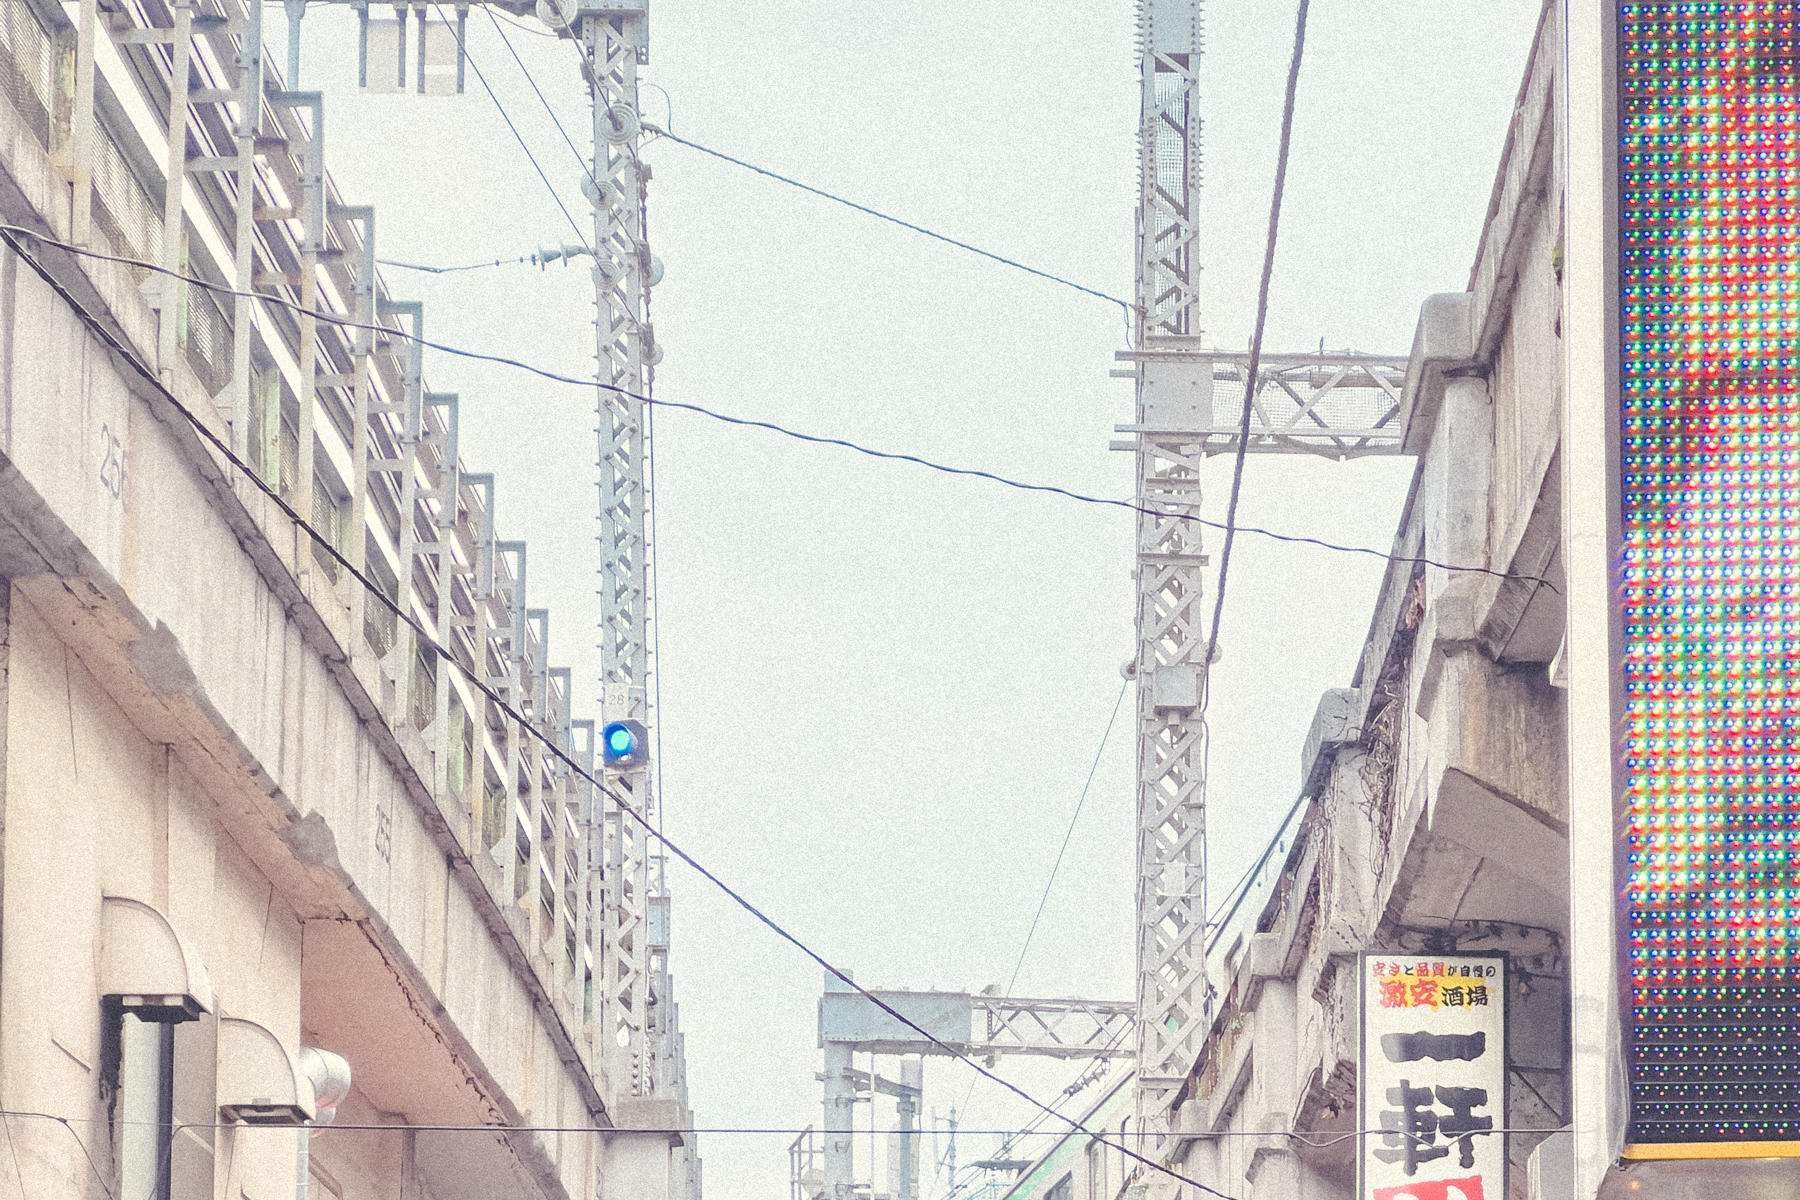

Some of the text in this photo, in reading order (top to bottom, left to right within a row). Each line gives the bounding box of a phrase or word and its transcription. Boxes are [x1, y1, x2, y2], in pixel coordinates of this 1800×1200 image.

[1372, 960, 1497, 978] 安さと品質が自慢の
[1379, 979, 1489, 1008] 激安酒場
